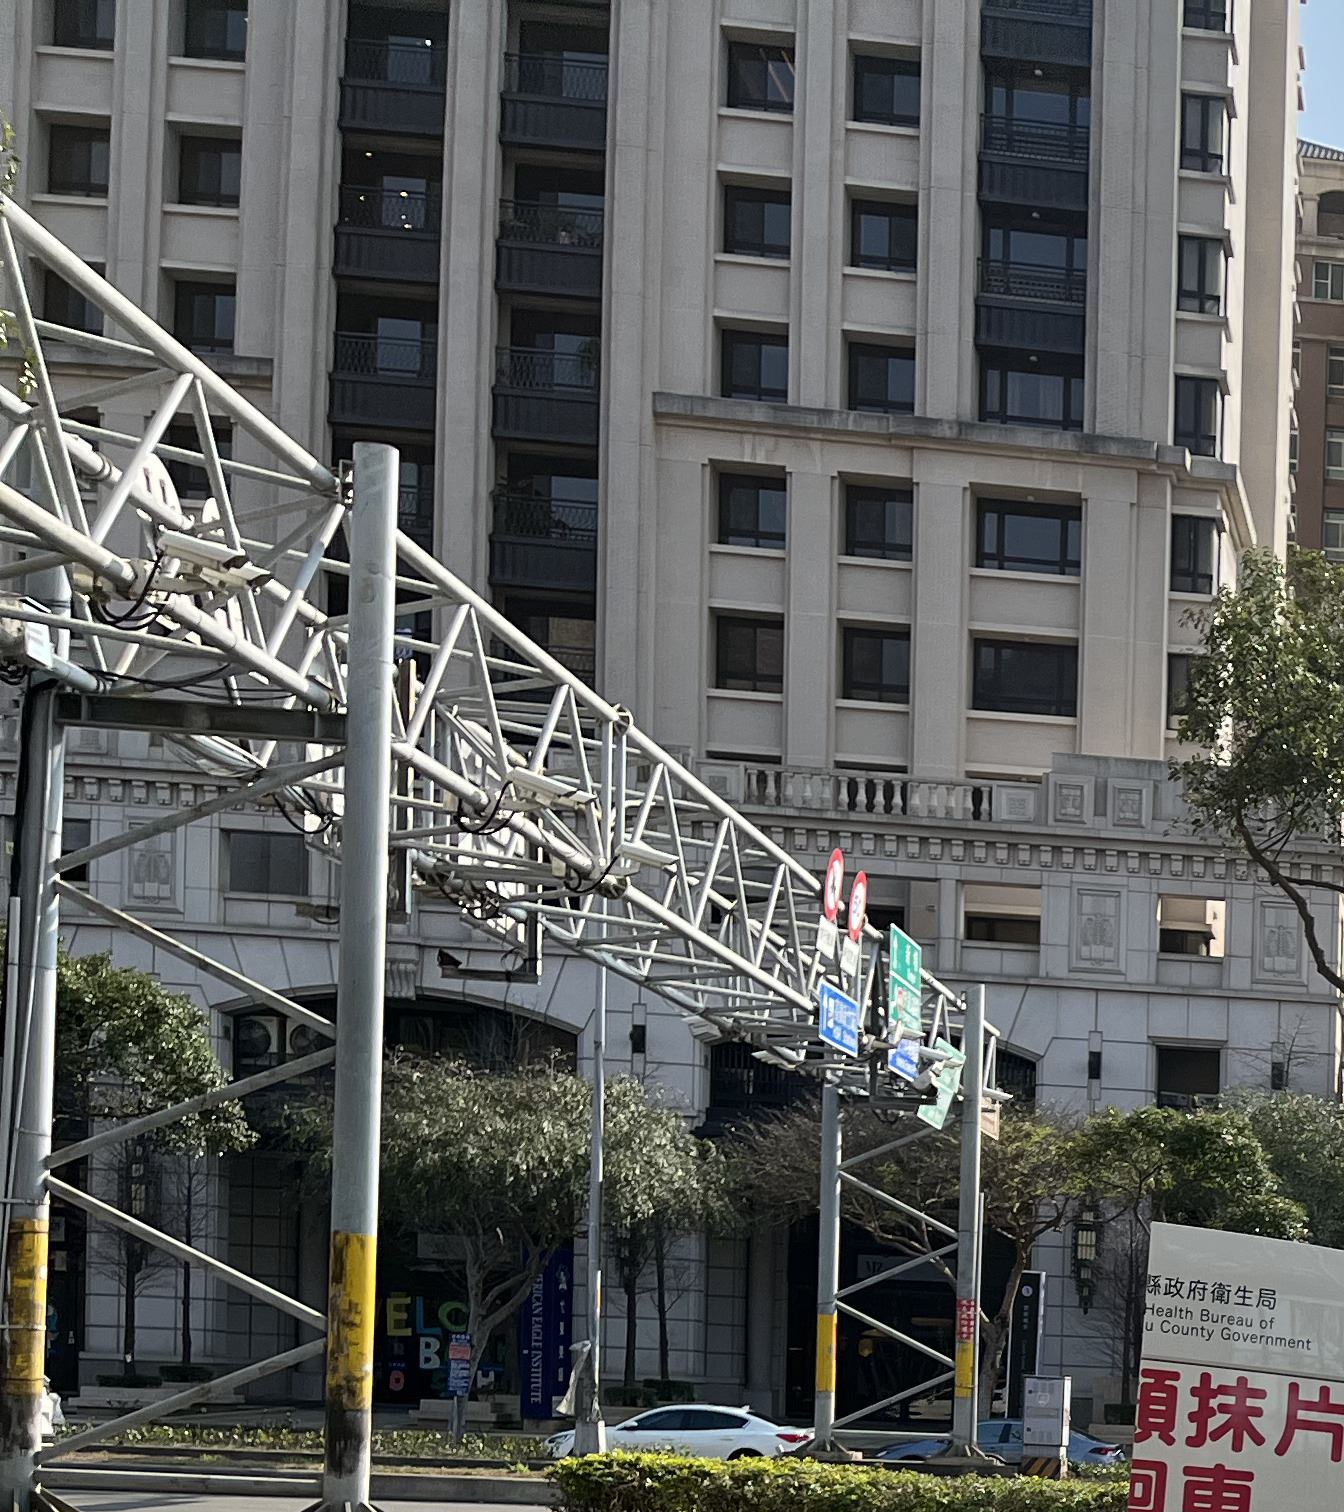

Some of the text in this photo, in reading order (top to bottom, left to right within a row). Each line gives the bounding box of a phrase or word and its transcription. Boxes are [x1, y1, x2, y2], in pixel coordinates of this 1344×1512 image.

[1144, 1302, 1275, 1330] Health Bureau of
[531, 1318, 543, 1349] EAGLE
[1160, 1321, 1215, 1342] County
[1221, 1327, 1312, 1350] Government
[530, 1351, 542, 1404] INSTITUTE
